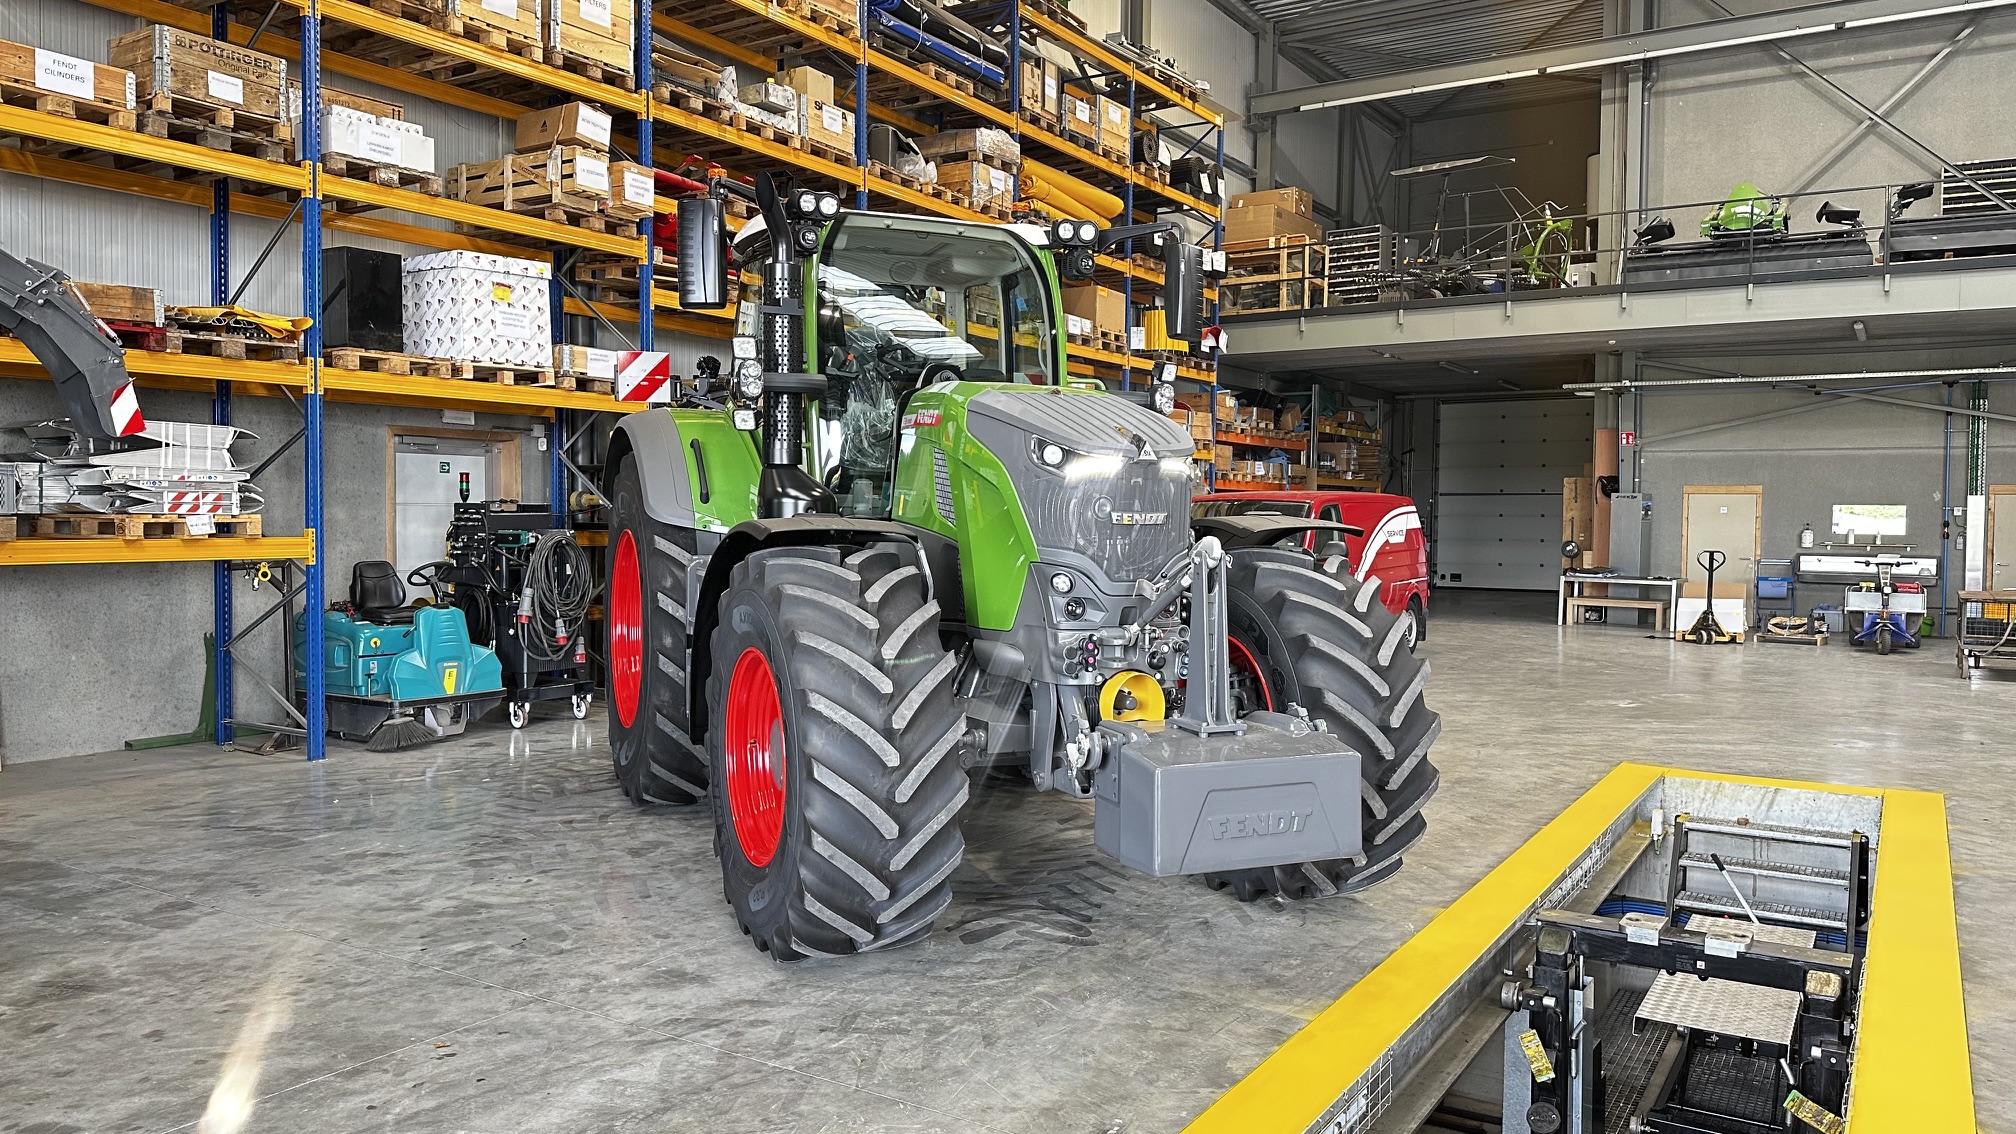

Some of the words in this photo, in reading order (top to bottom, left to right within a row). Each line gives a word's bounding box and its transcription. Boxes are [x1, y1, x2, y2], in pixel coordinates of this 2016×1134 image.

[52, 58, 78, 71] FENDT
[217, 58, 250, 75] Original
[44, 67, 86, 84] CILINDERS
[1110, 511, 1168, 526] FENDT
[1386, 529, 1405, 538] SERVICE
[1208, 808, 1313, 841] FENDT
